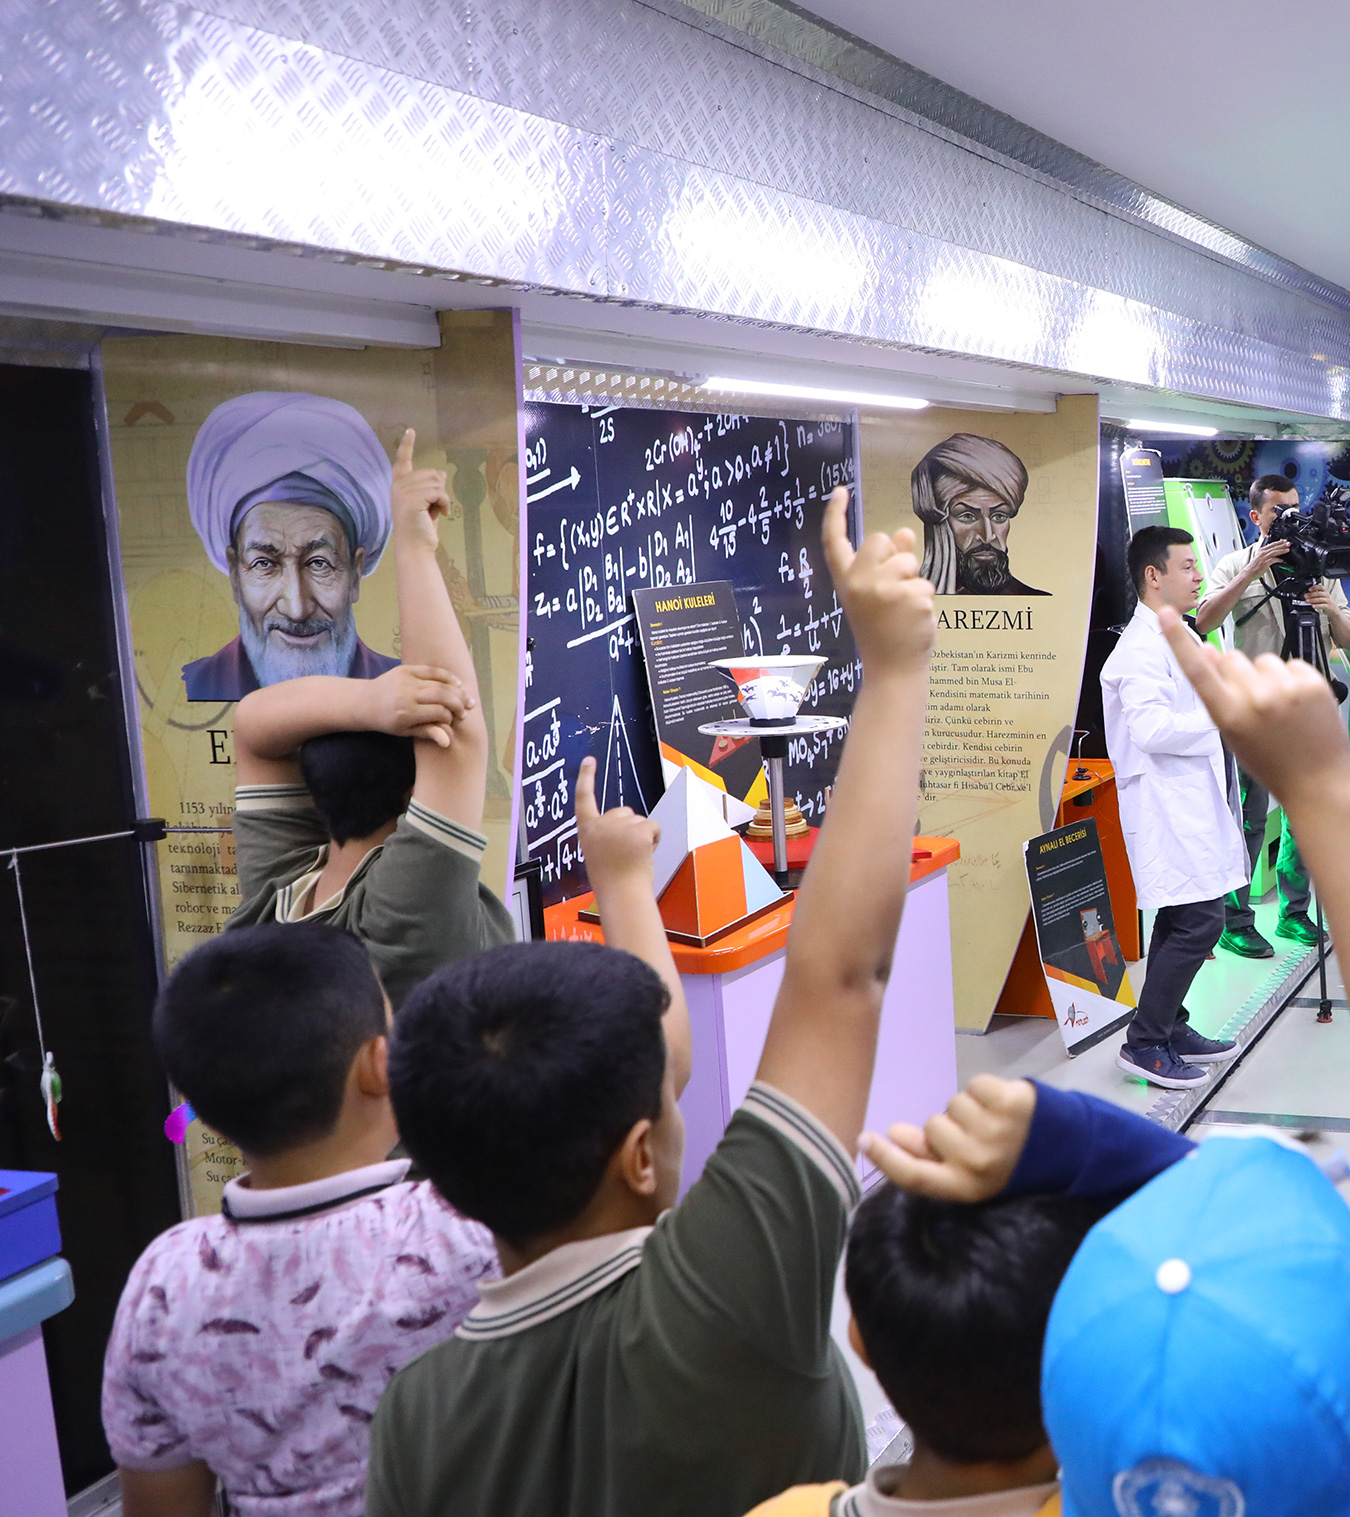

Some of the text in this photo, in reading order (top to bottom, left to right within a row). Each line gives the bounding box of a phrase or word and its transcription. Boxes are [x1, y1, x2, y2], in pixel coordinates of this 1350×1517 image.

[655, 592, 716, 613] HANOİ KULELERİ
[937, 606, 1034, 631] AREZMİ
[986, 651, 1018, 660] Karizmi
[1020, 651, 1057, 660] kentinde
[951, 663, 969, 672] Tam
[971, 664, 997, 673] olarak
[998, 664, 1015, 673] ismi
[1018, 664, 1034, 673] Ebu
[966, 677, 979, 686] bin
[981, 677, 1003, 686] Musa
[930, 690, 1050, 700] Kendisini matematik tarihinin
[940, 703, 964, 711] adamı
[966, 703, 991, 712] olarak
[945, 715, 972, 726] Çünkü
[974, 716, 1002, 725] cebirin
[931, 729, 985, 738] kurucusudur.
[986, 730, 1035, 739] Harezminin
[1036, 732, 1047, 740] en
[927, 741, 1023, 752] cebirdir. Kendisi cebirin
[930, 755, 986, 765] geliştiricisidir.
[988, 756, 999, 765] Bu
[1001, 756, 1031, 766] konuda
[934, 769, 996, 779] yaygınlaştırılan
[998, 769, 1019, 780] kitap
[180, 802, 205, 815] 1153
[168, 842, 221, 858] teknoloji
[170, 863, 237, 875] tanınmaktad
[172, 881, 228, 895] Sibernetik
[175, 901, 204, 914] robot
[206, 905, 219, 914] ve
[177, 920, 214, 934] Rezzaz
[202, 1133, 215, 1144] Su
[206, 1170, 219, 1182] Su
